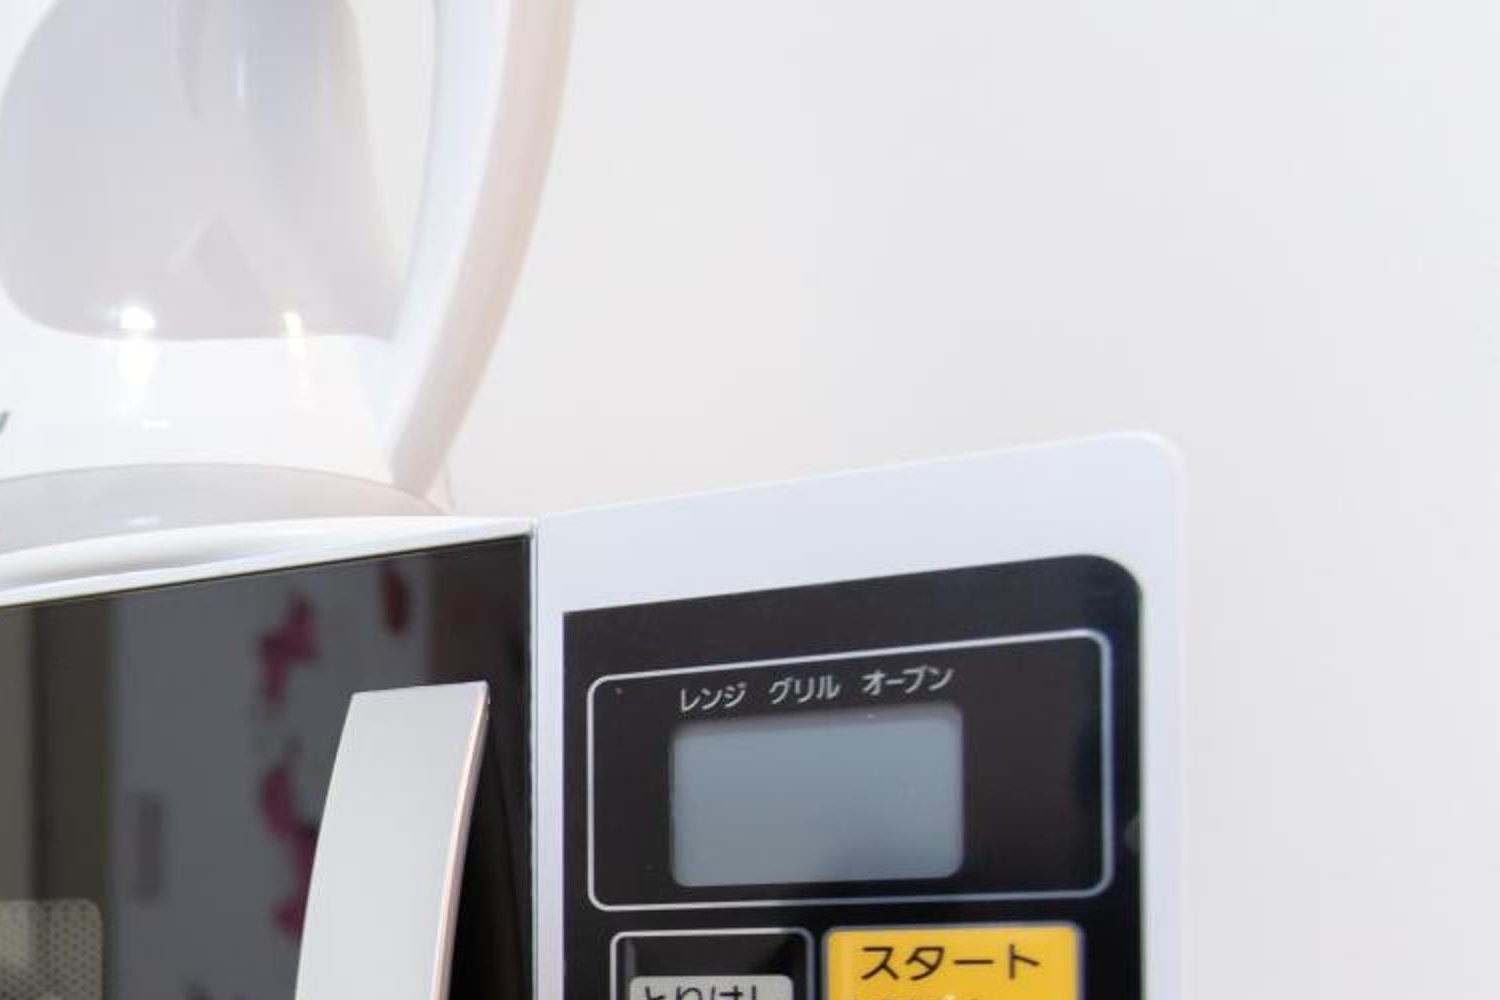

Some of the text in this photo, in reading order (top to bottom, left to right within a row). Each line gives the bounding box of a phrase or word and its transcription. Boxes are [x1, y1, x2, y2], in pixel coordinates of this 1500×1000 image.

[679, 665, 954, 713] レンジ グリル オープン
[861, 944, 1040, 982] スタート
